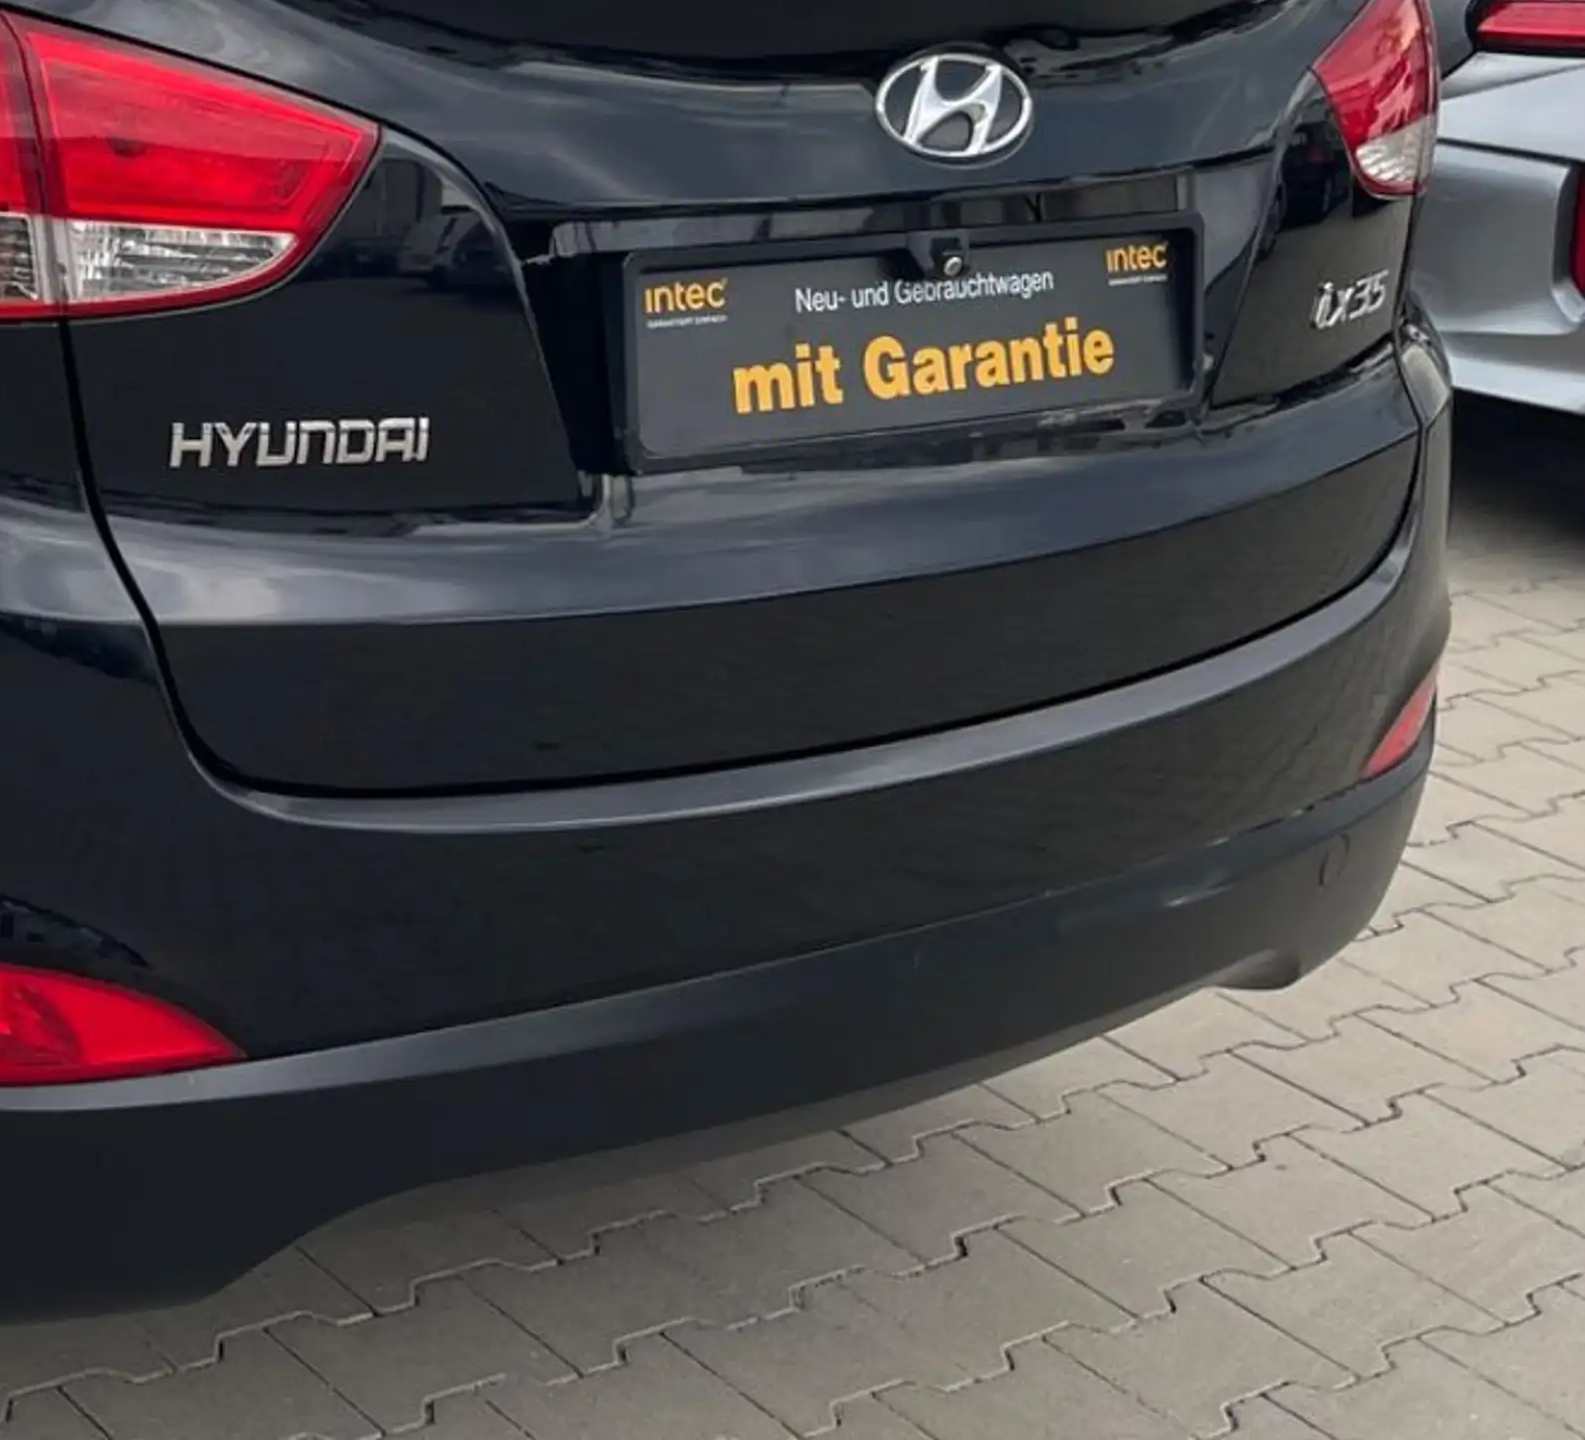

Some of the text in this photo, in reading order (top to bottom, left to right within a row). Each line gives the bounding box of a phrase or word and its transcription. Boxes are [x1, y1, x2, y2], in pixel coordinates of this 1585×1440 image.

[795, 270, 1054, 313] Neu- und Gebrauchtwagen
[1314, 269, 1390, 329] ix35
[733, 316, 1114, 414] mit Garantie
[168, 417, 430, 468] HYUNDAI
